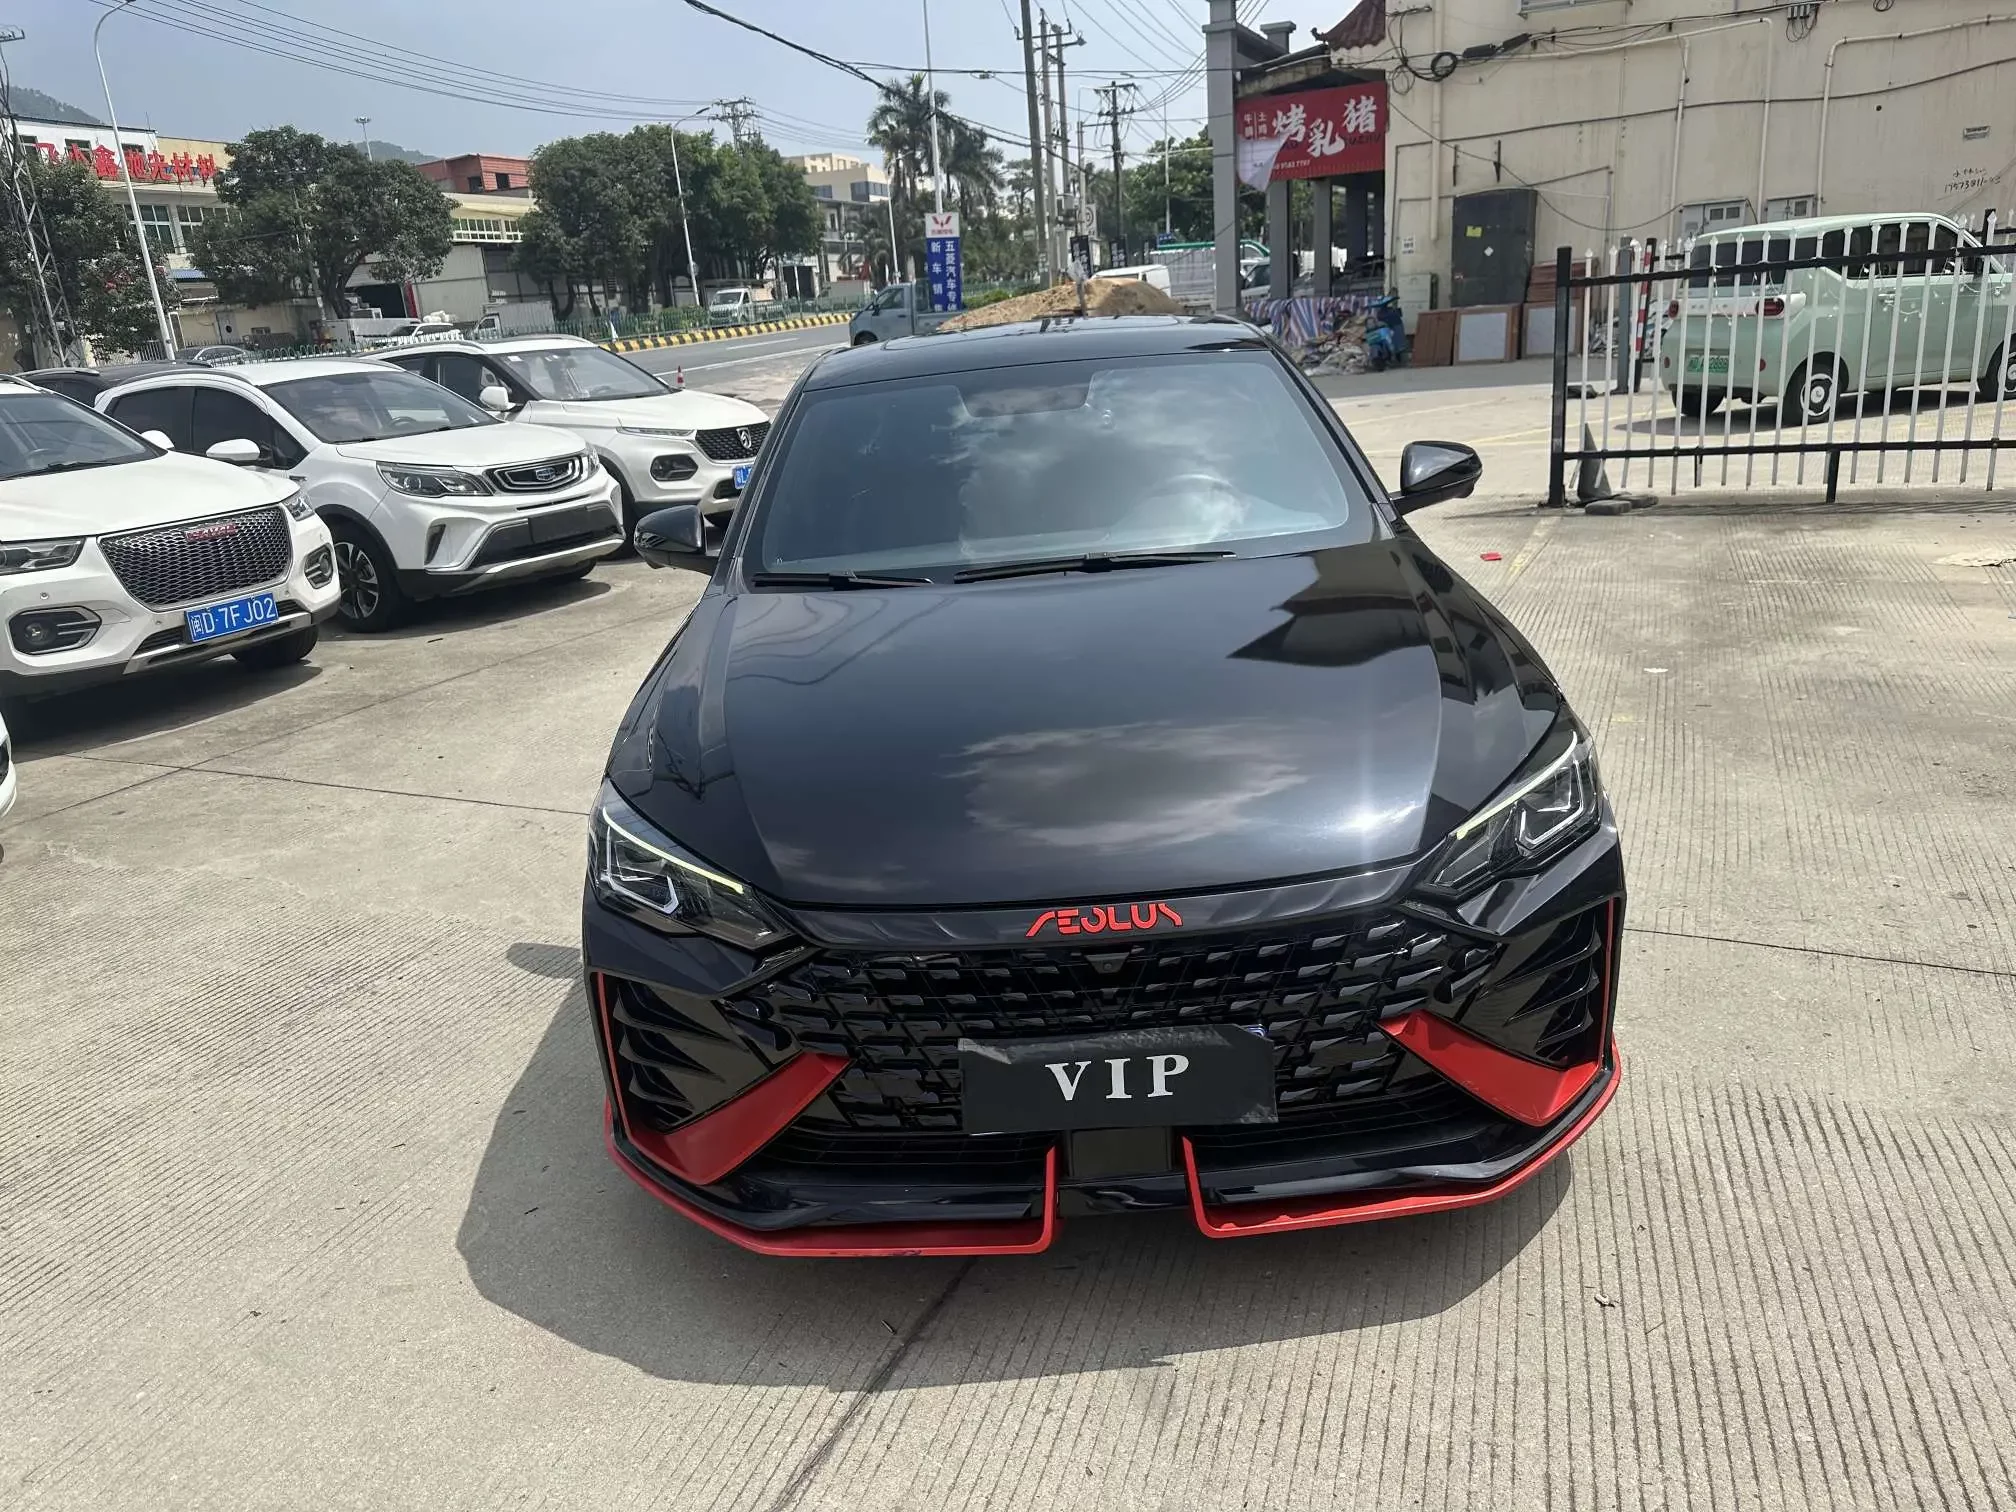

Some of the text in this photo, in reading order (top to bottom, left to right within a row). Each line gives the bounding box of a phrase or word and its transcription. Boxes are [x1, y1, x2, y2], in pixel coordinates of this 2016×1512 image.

[1271, 95, 1377, 158] 烤乳猪
[1045, 1054, 1190, 1101] VIP
